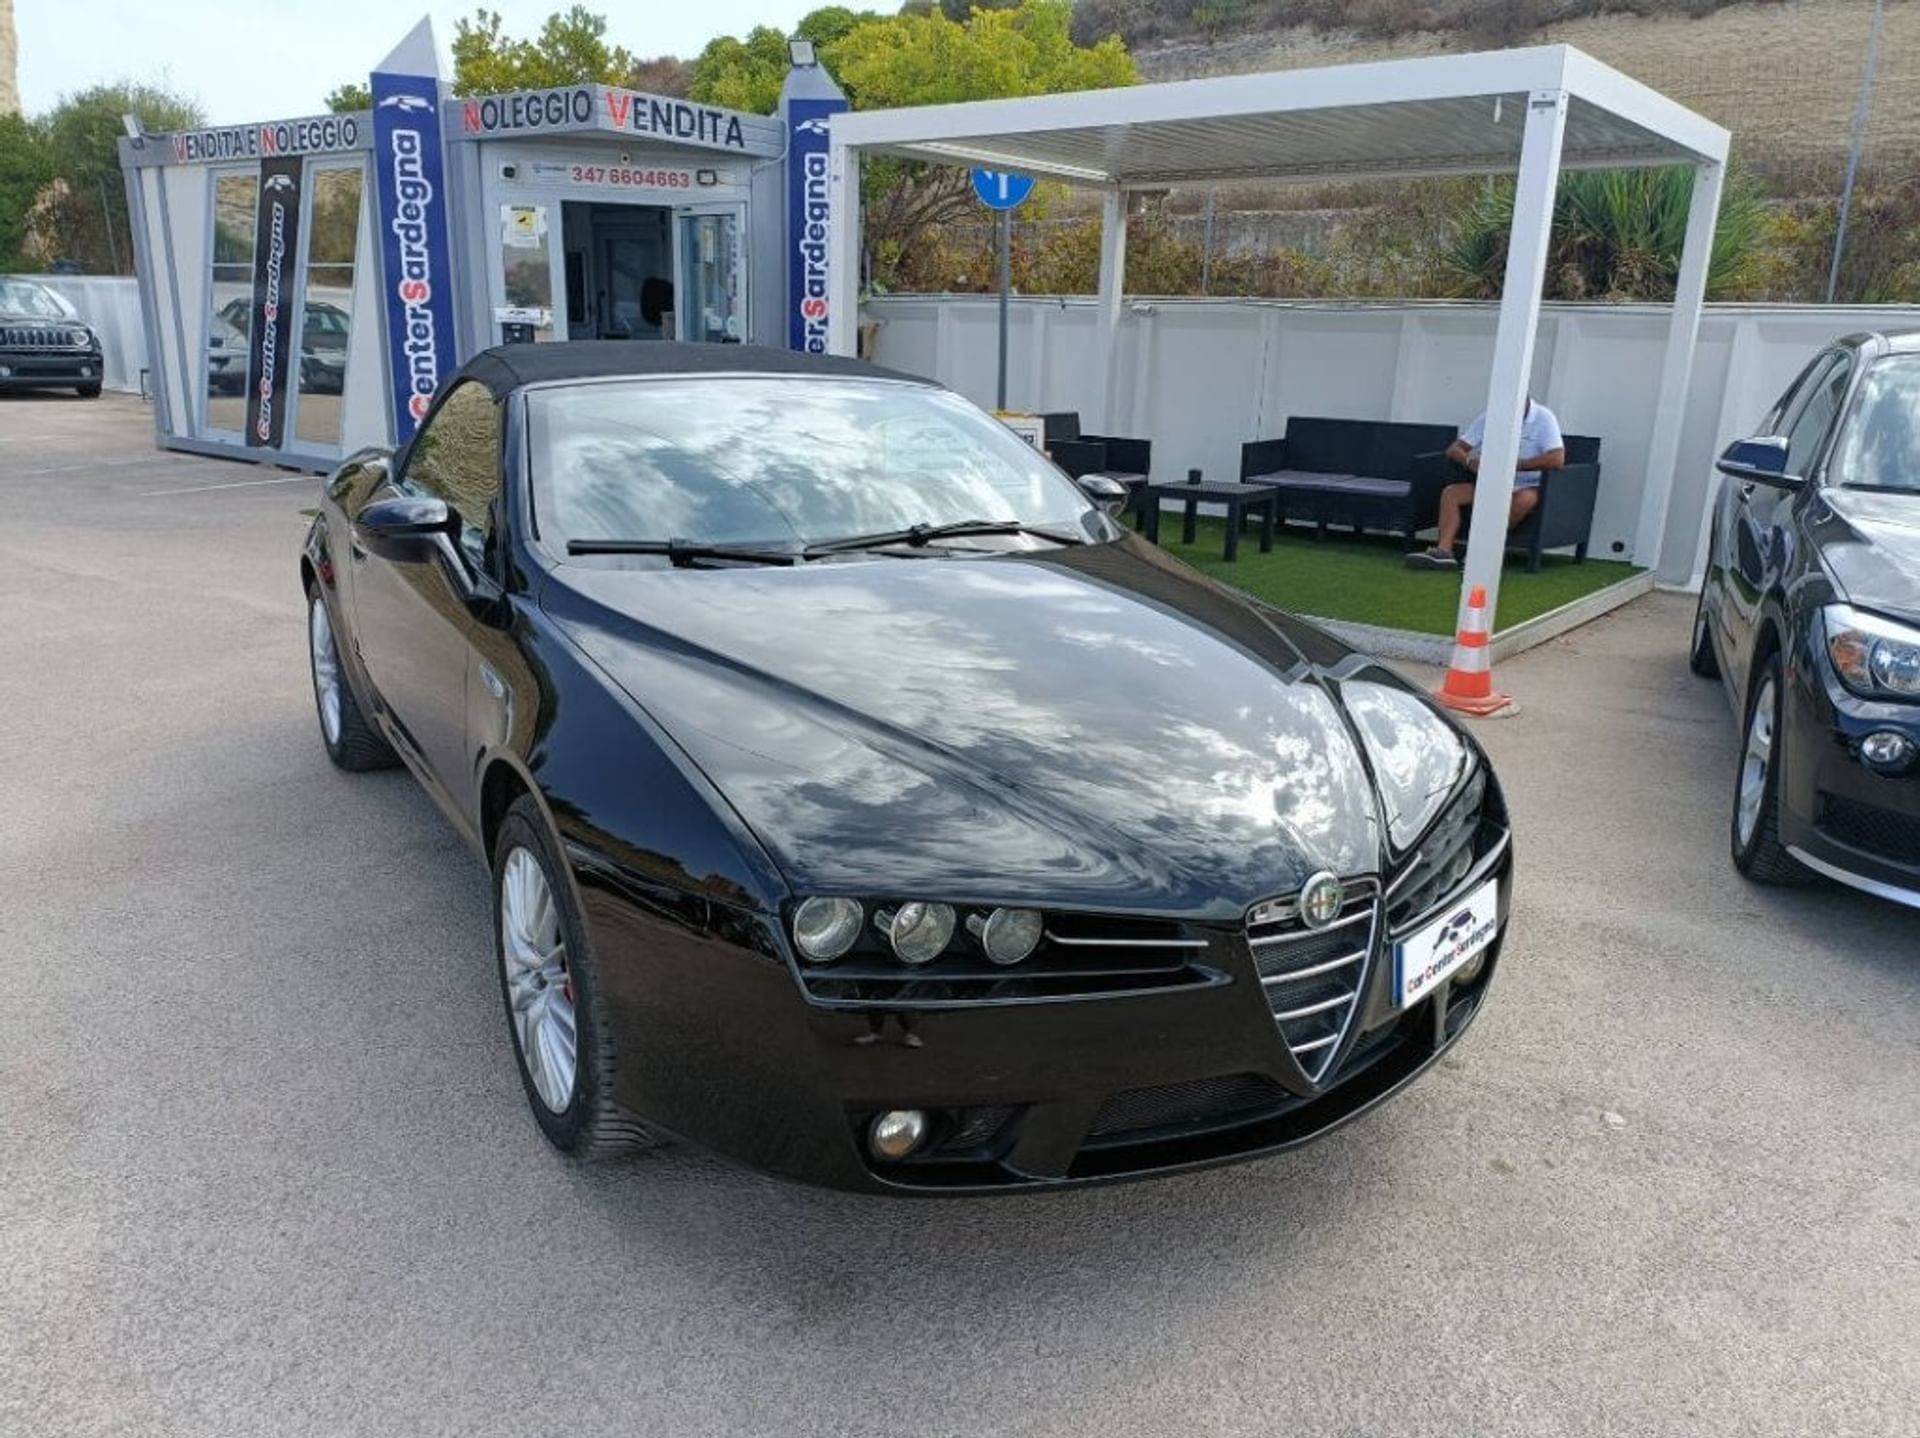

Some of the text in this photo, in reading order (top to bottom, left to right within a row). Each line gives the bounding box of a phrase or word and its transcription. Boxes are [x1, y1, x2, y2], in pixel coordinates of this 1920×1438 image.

[174, 117, 358, 162] VENDITA E NOLEGGIO
[463, 90, 744, 148] NOLEGGIO VENDITA
[571, 165, 606, 183] 347
[609, 167, 690, 188] 6604663
[393, 129, 437, 426] CenterSardegna
